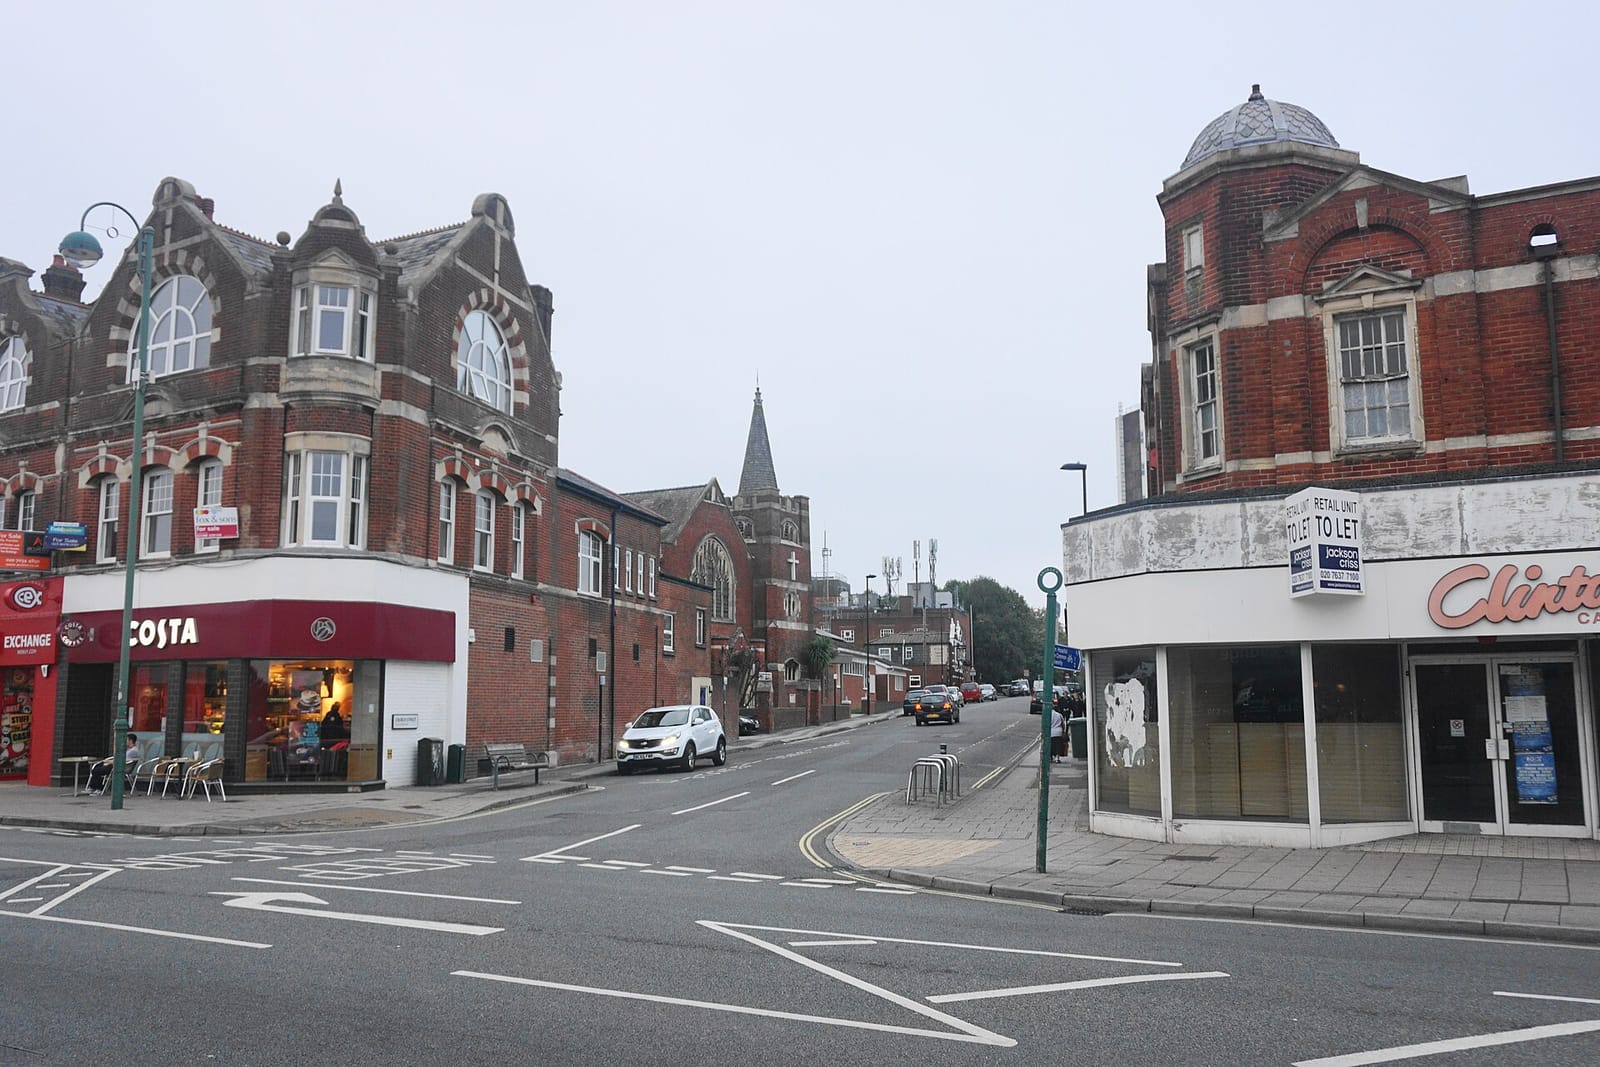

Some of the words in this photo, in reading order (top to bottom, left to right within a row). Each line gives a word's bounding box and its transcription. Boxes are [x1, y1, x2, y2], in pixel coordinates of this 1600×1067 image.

[1286, 504, 1301, 518] RETAIL
[1314, 497, 1340, 512] RETAIL
[1341, 501, 1357, 514] UNIT
[1287, 522, 1298, 545] TO
[1298, 516, 1311, 541] LET
[1315, 515, 1332, 538] TO
[1336, 517, 1359, 540] LET
[1293, 547, 1312, 563] jackson
[1326, 546, 1358, 560] jackson
[1301, 558, 1312, 569] criss
[1339, 558, 1359, 569] criss
[1320, 570, 1331, 579] 020
[1332, 571, 1345, 580] 7637
[1346, 572, 1359, 581] 7100
[64, 621, 83, 630] COSTA
[129, 617, 198, 649] COSTA
[4, 633, 52, 649] EXCHANGE
[11, 715, 30, 724] STUFF
[278, 854, 497, 880] KEEP
